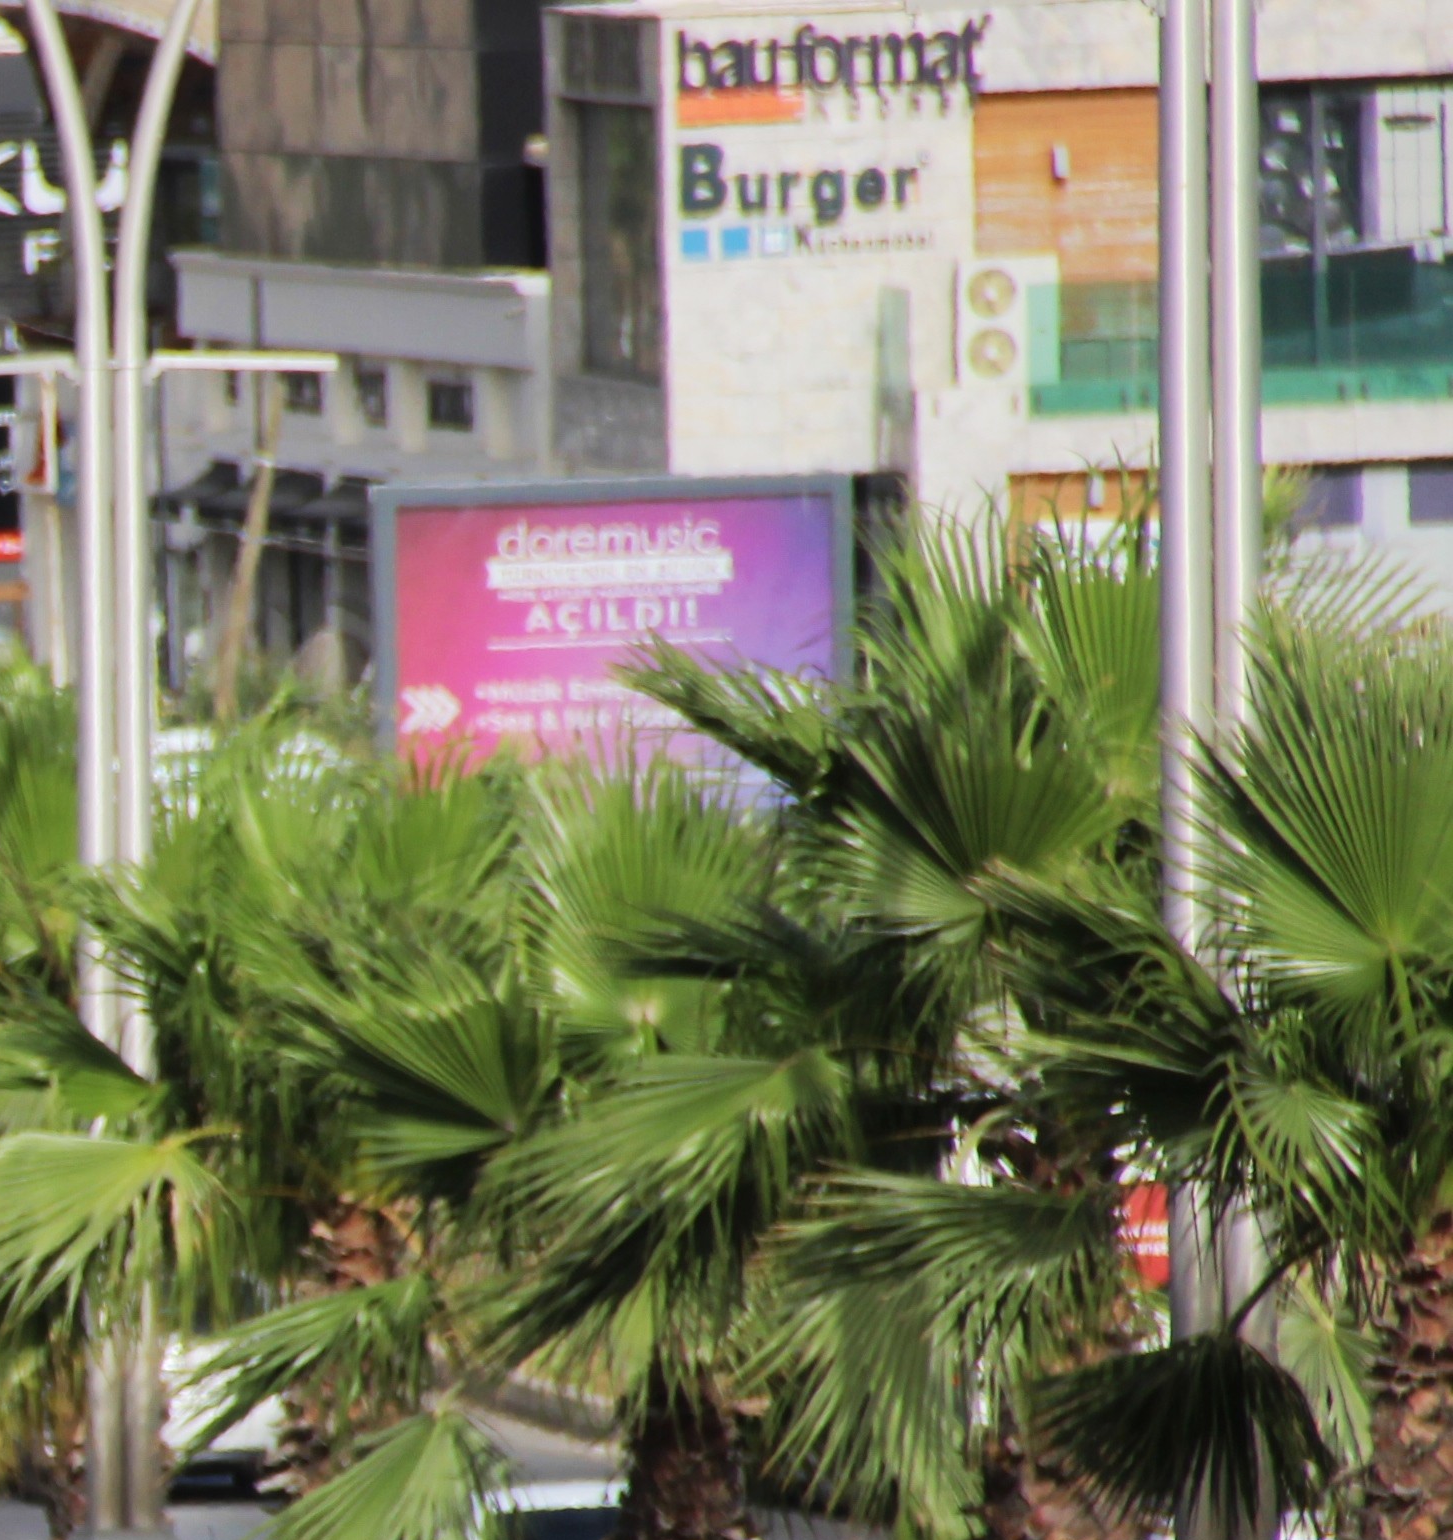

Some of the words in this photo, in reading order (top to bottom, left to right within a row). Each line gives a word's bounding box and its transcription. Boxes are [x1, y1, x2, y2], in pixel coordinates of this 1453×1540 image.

[676, 18, 985, 93] bauformat
[679, 143, 919, 226] Burger
[497, 517, 721, 559] doremusic
[527, 600, 697, 638] AÇILDI!
